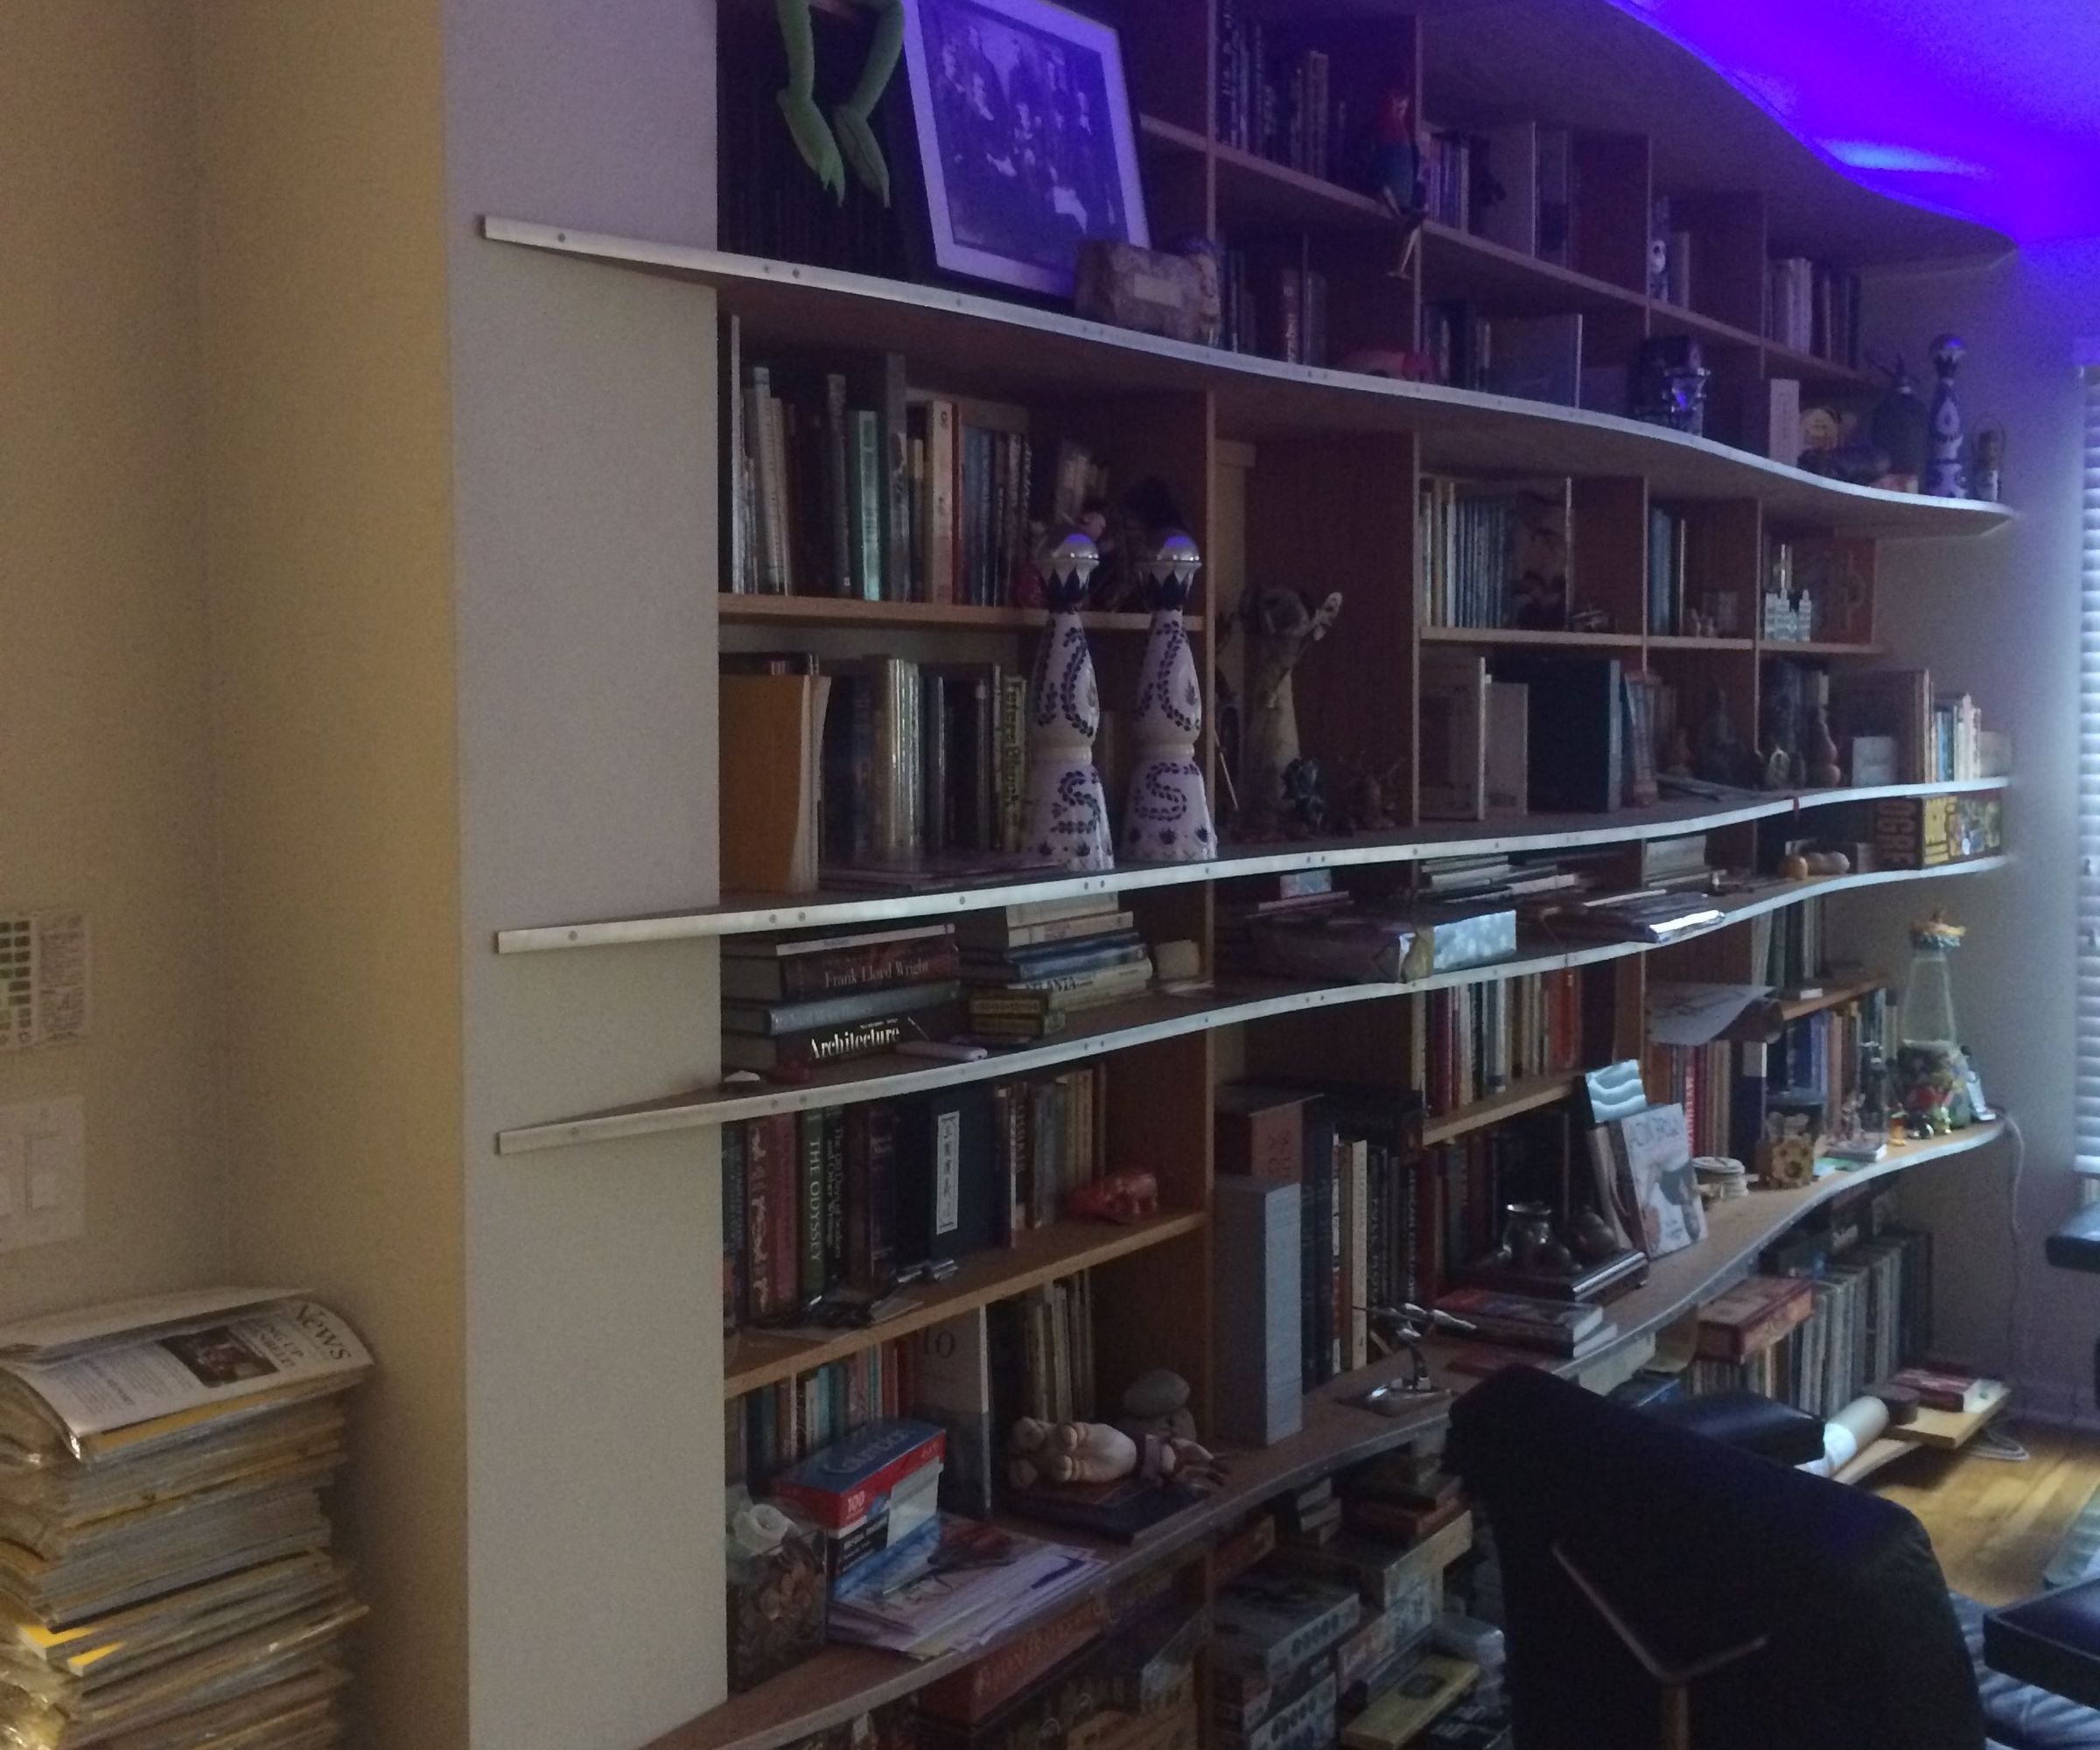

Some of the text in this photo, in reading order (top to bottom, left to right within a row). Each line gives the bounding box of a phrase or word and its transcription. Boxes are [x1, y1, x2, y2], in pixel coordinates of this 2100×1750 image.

[1875, 799, 1916, 867] OGRE
[825, 967, 858, 988] Frank
[860, 962, 892, 982] Lloyd
[894, 958, 929, 977] Wright
[809, 1026, 900, 1060] Architecture
[809, 1139, 821, 1262] THE ODYSSEY
[297, 1305, 352, 1360] News
[847, 1489, 866, 1514] 100
